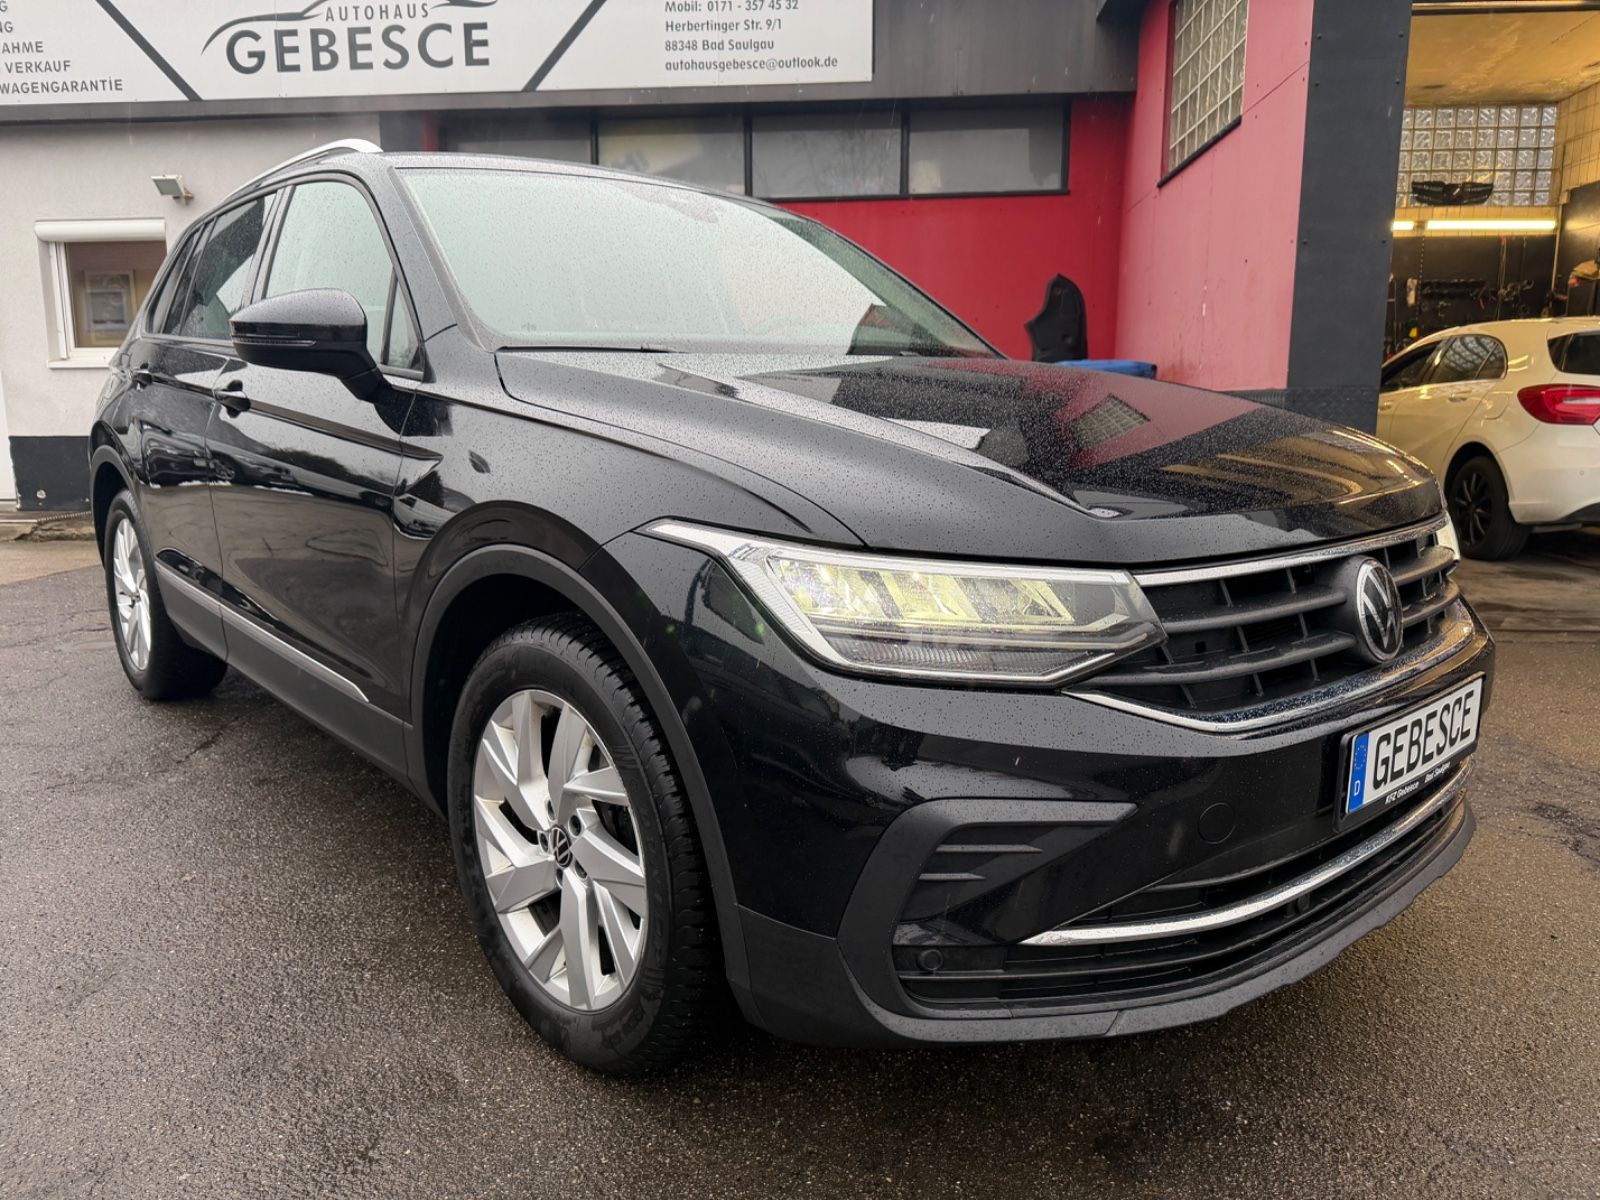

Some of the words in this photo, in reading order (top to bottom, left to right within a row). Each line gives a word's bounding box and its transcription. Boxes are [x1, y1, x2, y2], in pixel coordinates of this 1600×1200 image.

[325, 2, 429, 22] AUTOHAUS
[664, 1, 702, 12] Mobil:
[707, 0, 733, 11] 0171
[745, 0, 764, 11] 357
[768, 0, 782, 10] 45
[785, 0, 799, 10] 32
[665, 20, 740, 33] Herbertinger
[743, 19, 763, 31] Str.
[765, 19, 782, 31] 9/1
[226, 22, 490, 74] GEBESCE
[665, 40, 698, 51] 88348
[702, 39, 725, 51] Bad
[728, 38, 775, 53] Saulgau
[4, 60, 71, 74] VERKAUF
[665, 56, 838, 72] autohausgebesce@outlook.de
[1372, 689, 1474, 790] GEBESCE
[1353, 779, 1361, 796] D
